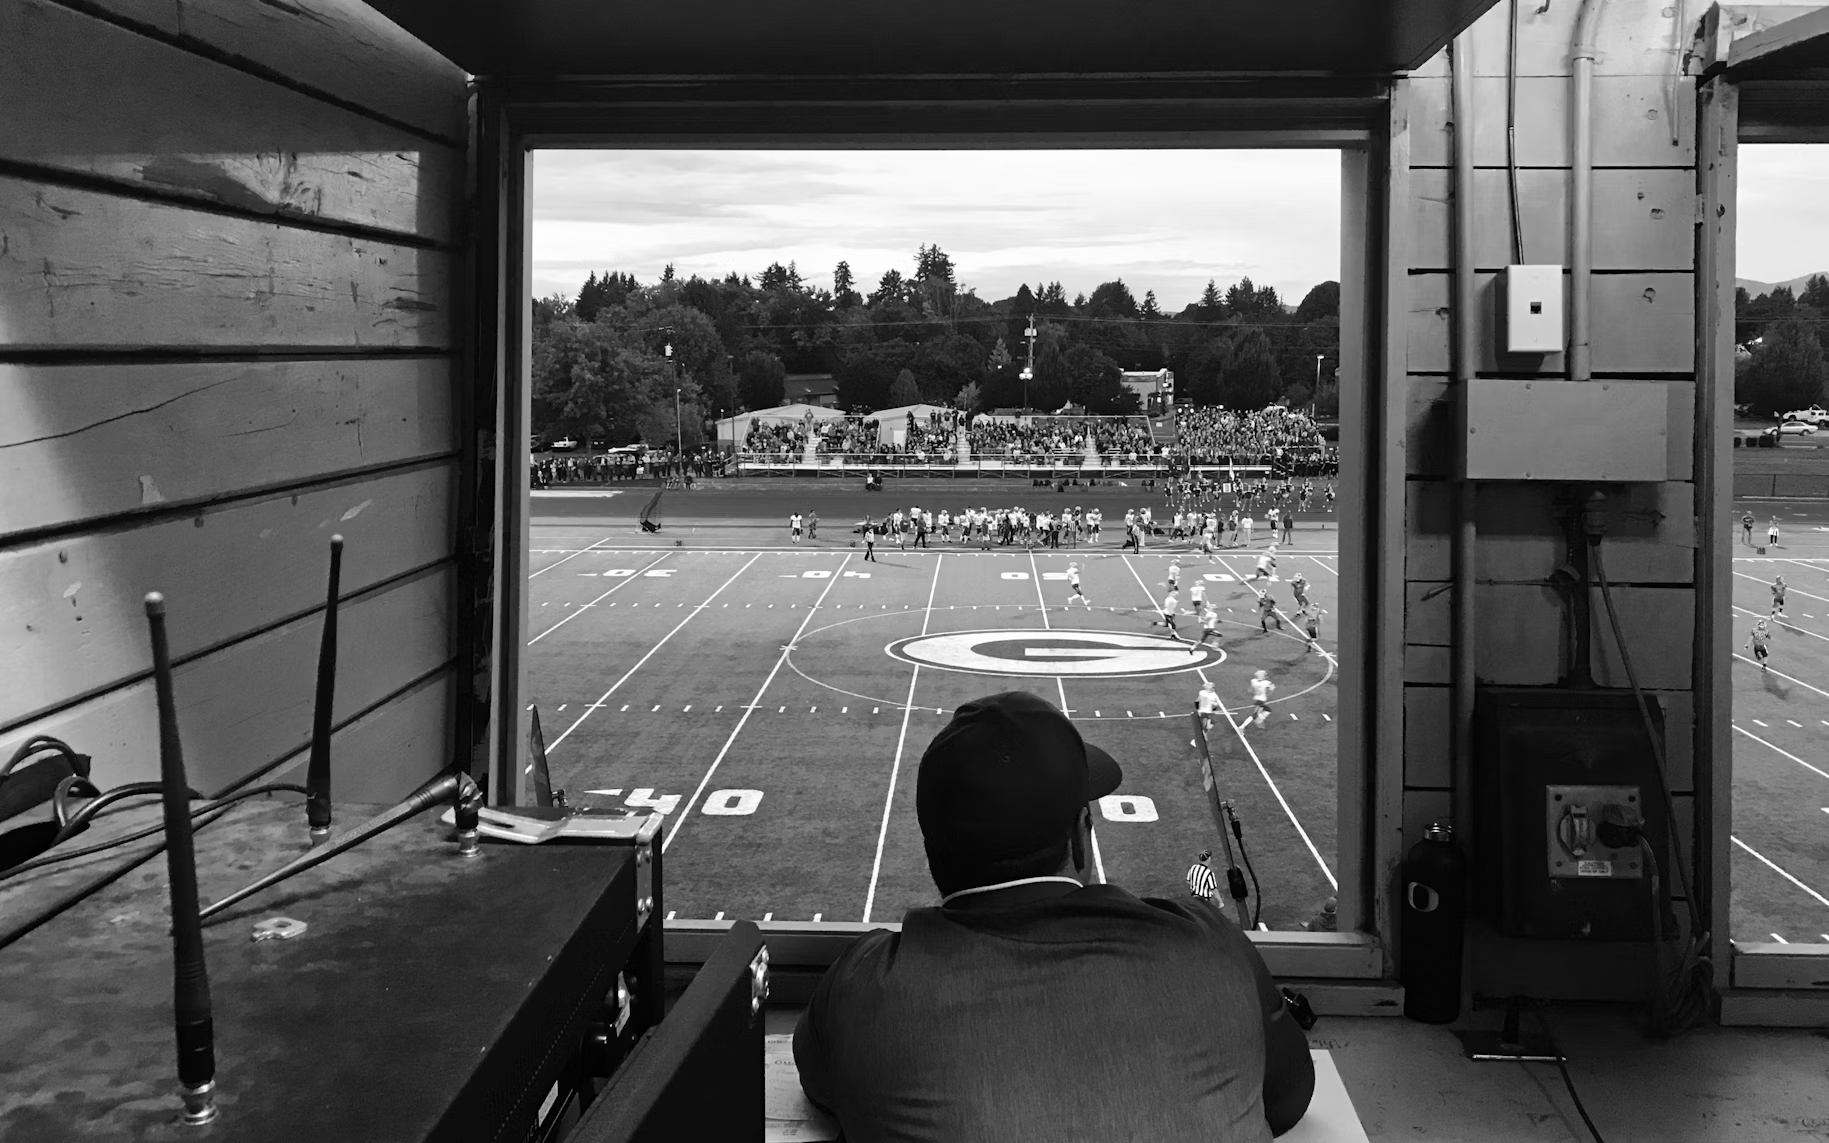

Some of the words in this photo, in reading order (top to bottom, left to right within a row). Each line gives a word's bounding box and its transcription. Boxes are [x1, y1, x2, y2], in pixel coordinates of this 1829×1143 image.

[902, 630, 1208, 675] G
[623, 788, 765, 816] 40
[1098, 794, 1160, 823] 0
